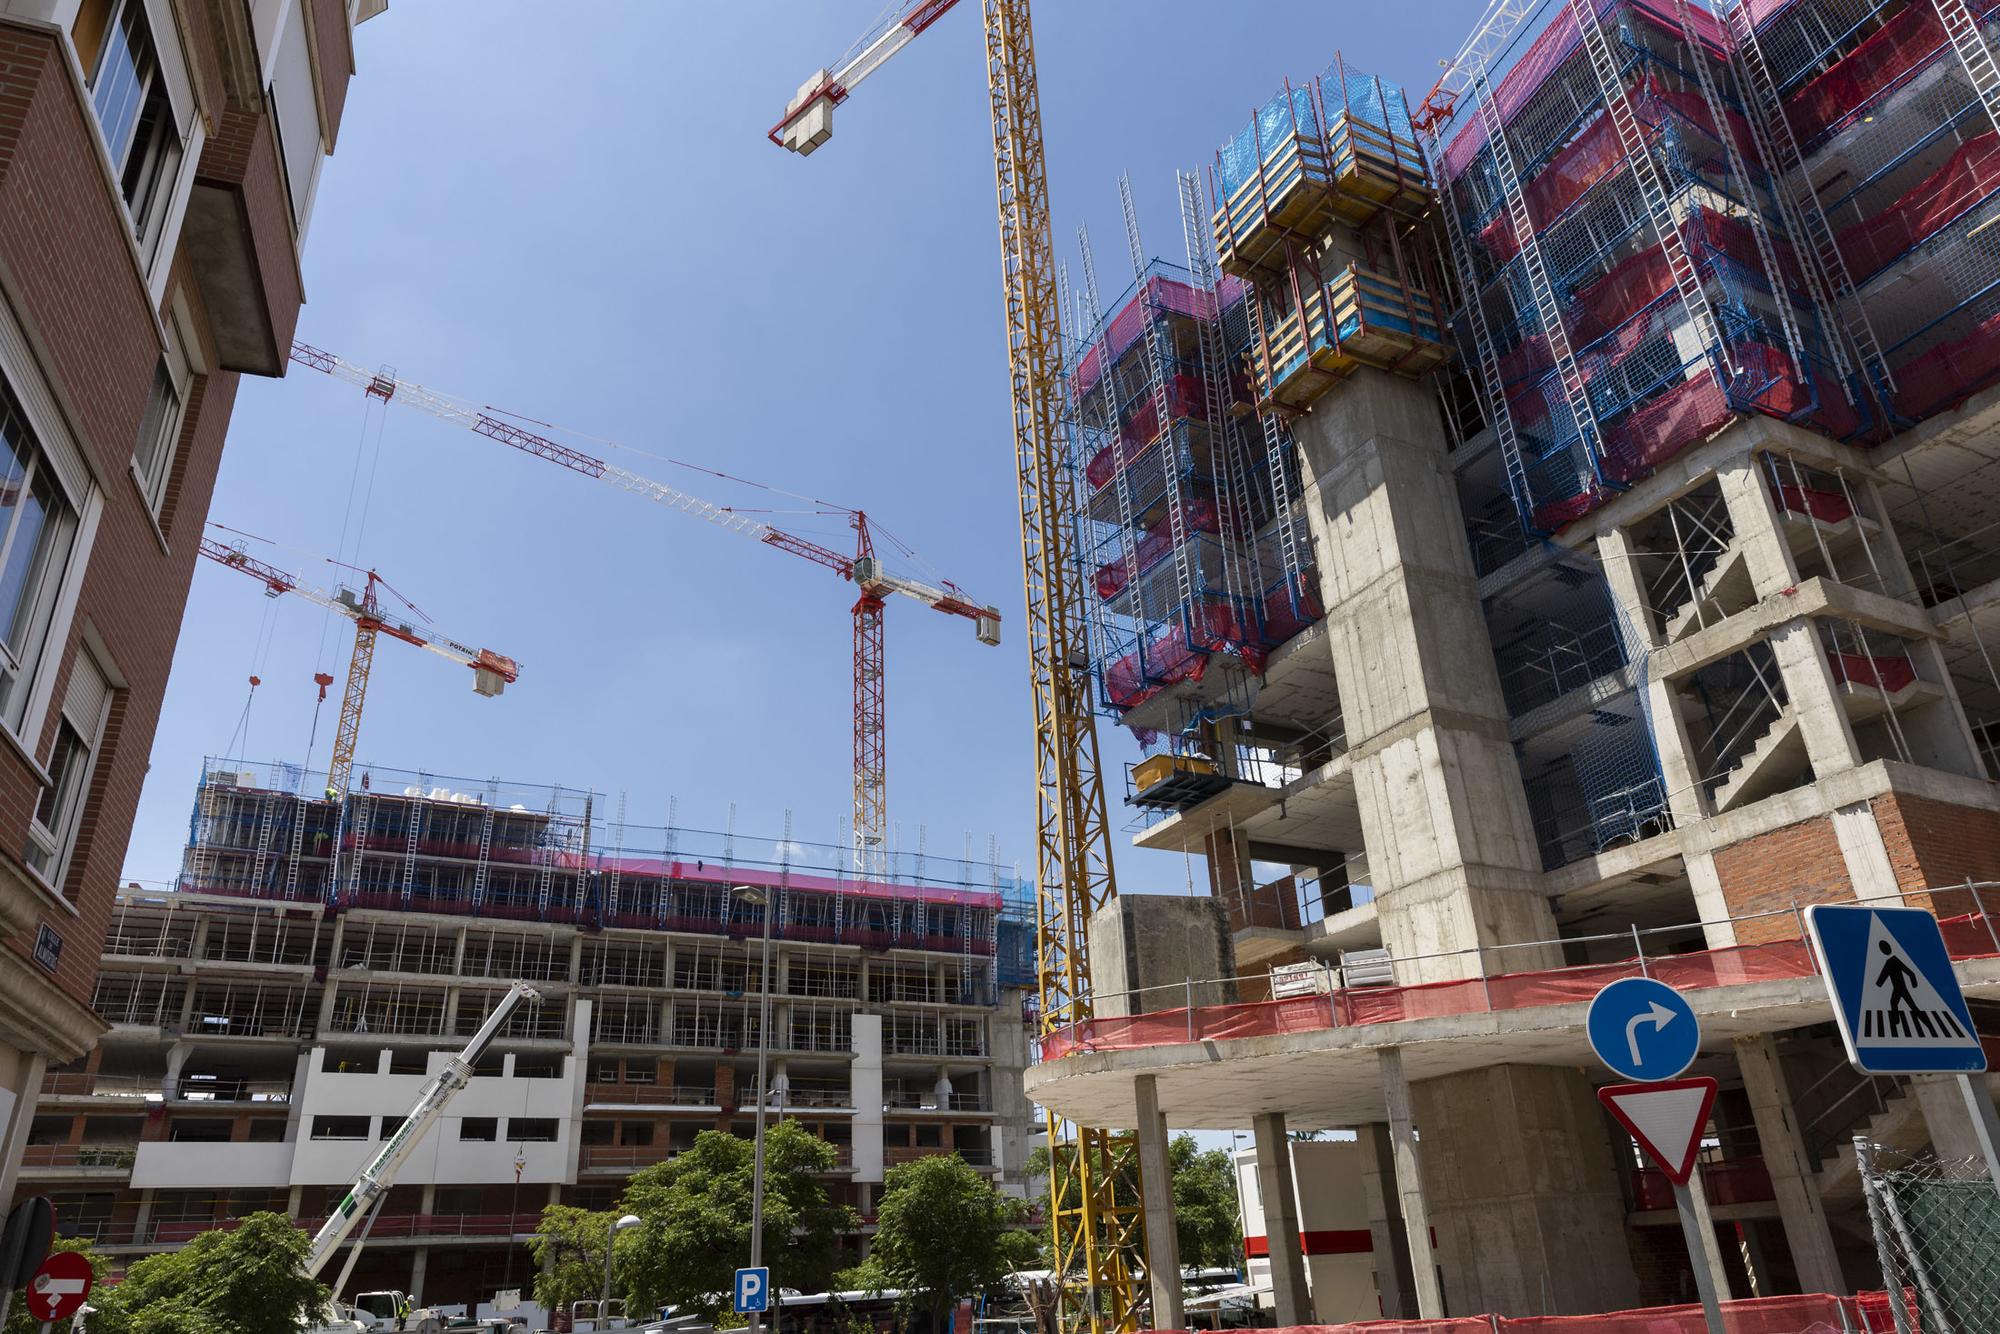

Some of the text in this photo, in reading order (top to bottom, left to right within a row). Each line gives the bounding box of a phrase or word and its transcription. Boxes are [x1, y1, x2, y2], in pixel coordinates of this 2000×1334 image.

[449, 642, 473, 656] POTAIN
[369, 1120, 413, 1175] TRANSGRUMA
[741, 1274, 761, 1307] P
